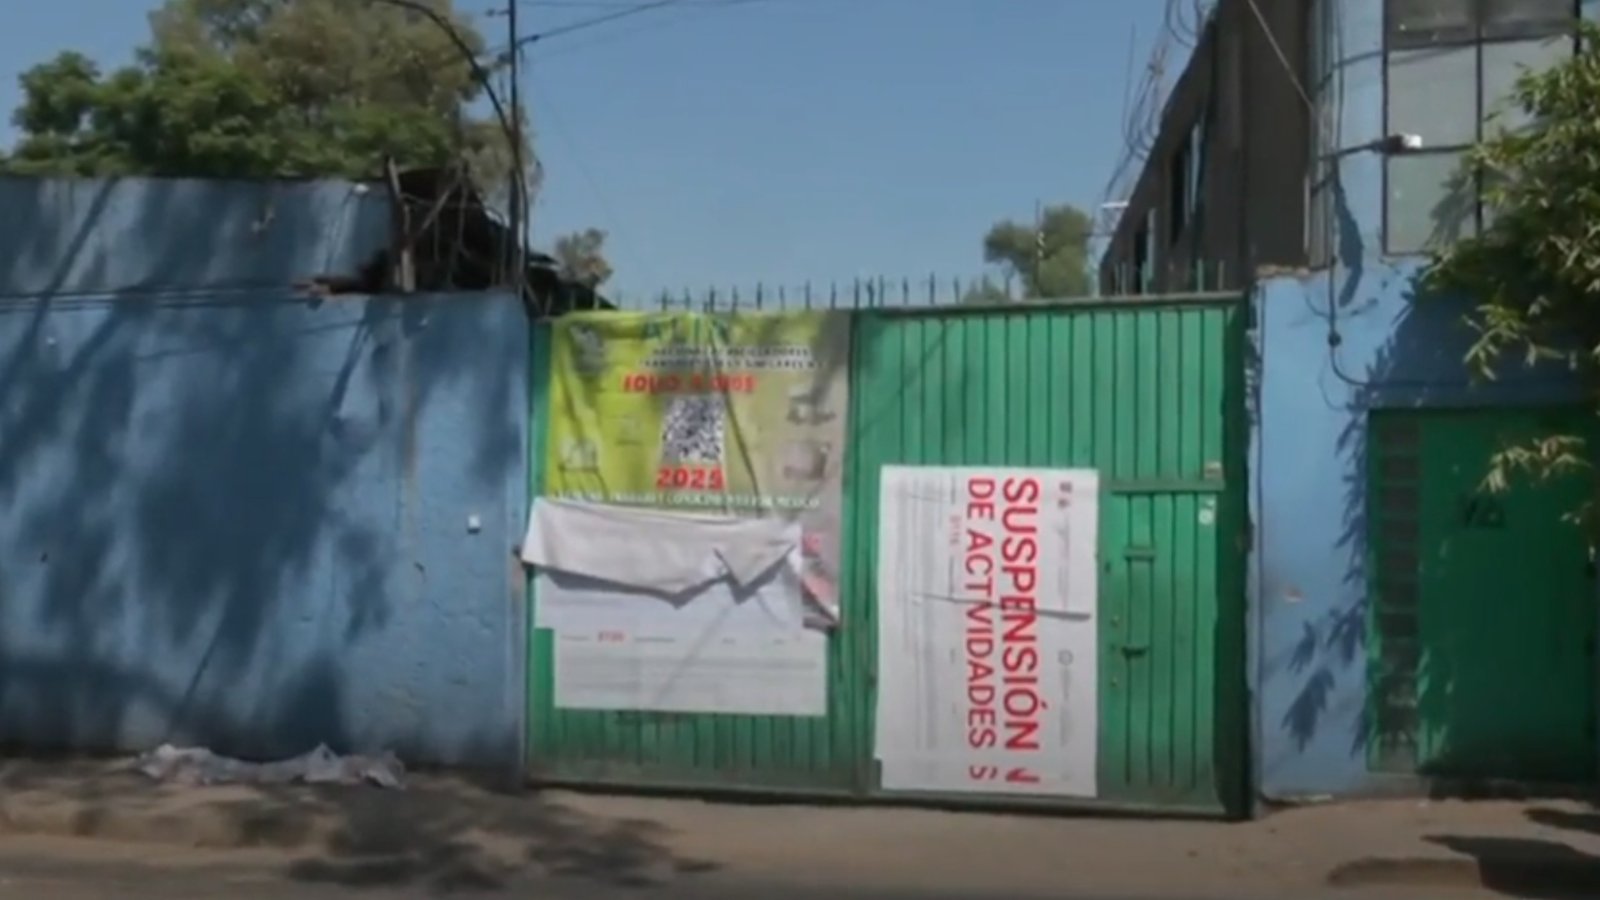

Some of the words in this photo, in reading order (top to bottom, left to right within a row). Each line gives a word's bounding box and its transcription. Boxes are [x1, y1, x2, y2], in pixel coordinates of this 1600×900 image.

[657, 467, 724, 491] 2025
[966, 477, 996, 521] DE
[964, 529, 997, 750] ACTVIDADES
[1000, 478, 1047, 751] SUSPENSIÓN
